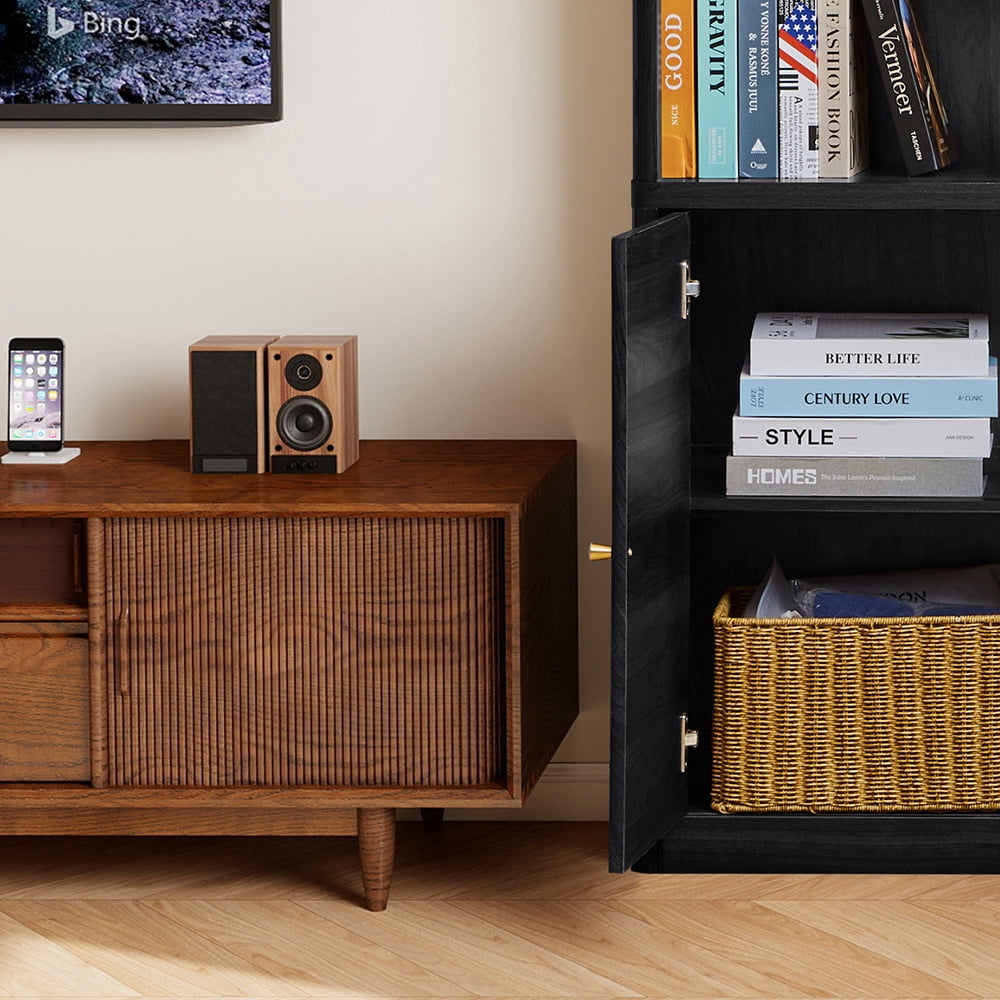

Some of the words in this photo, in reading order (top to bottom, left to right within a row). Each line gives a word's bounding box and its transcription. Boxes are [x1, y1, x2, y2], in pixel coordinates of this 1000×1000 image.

[83, 11, 141, 40] Bing
[760, 1, 769, 43] YVONNE
[749, 33, 757, 41] &
[664, 13, 683, 91] GOOD
[760, 44, 770, 76] KONÉ
[826, 12, 840, 101] FASHION
[749, 47, 758, 87] RASMUS
[878, 23, 913, 116] Vermeer
[671, 103, 679, 126] NICE
[748, 88, 758, 114] JUUL
[794, 96, 803, 104] A
[826, 107, 840, 163] BOOK
[910, 130, 923, 162] TASCHEN
[825, 353, 883, 365] BETTER
[887, 353, 921, 365] LIFE
[804, 392, 871, 406] CENTURY
[874, 392, 910, 406] LOVE
[765, 428, 834, 446] STYLE
[747, 468, 817, 485] HOMES
